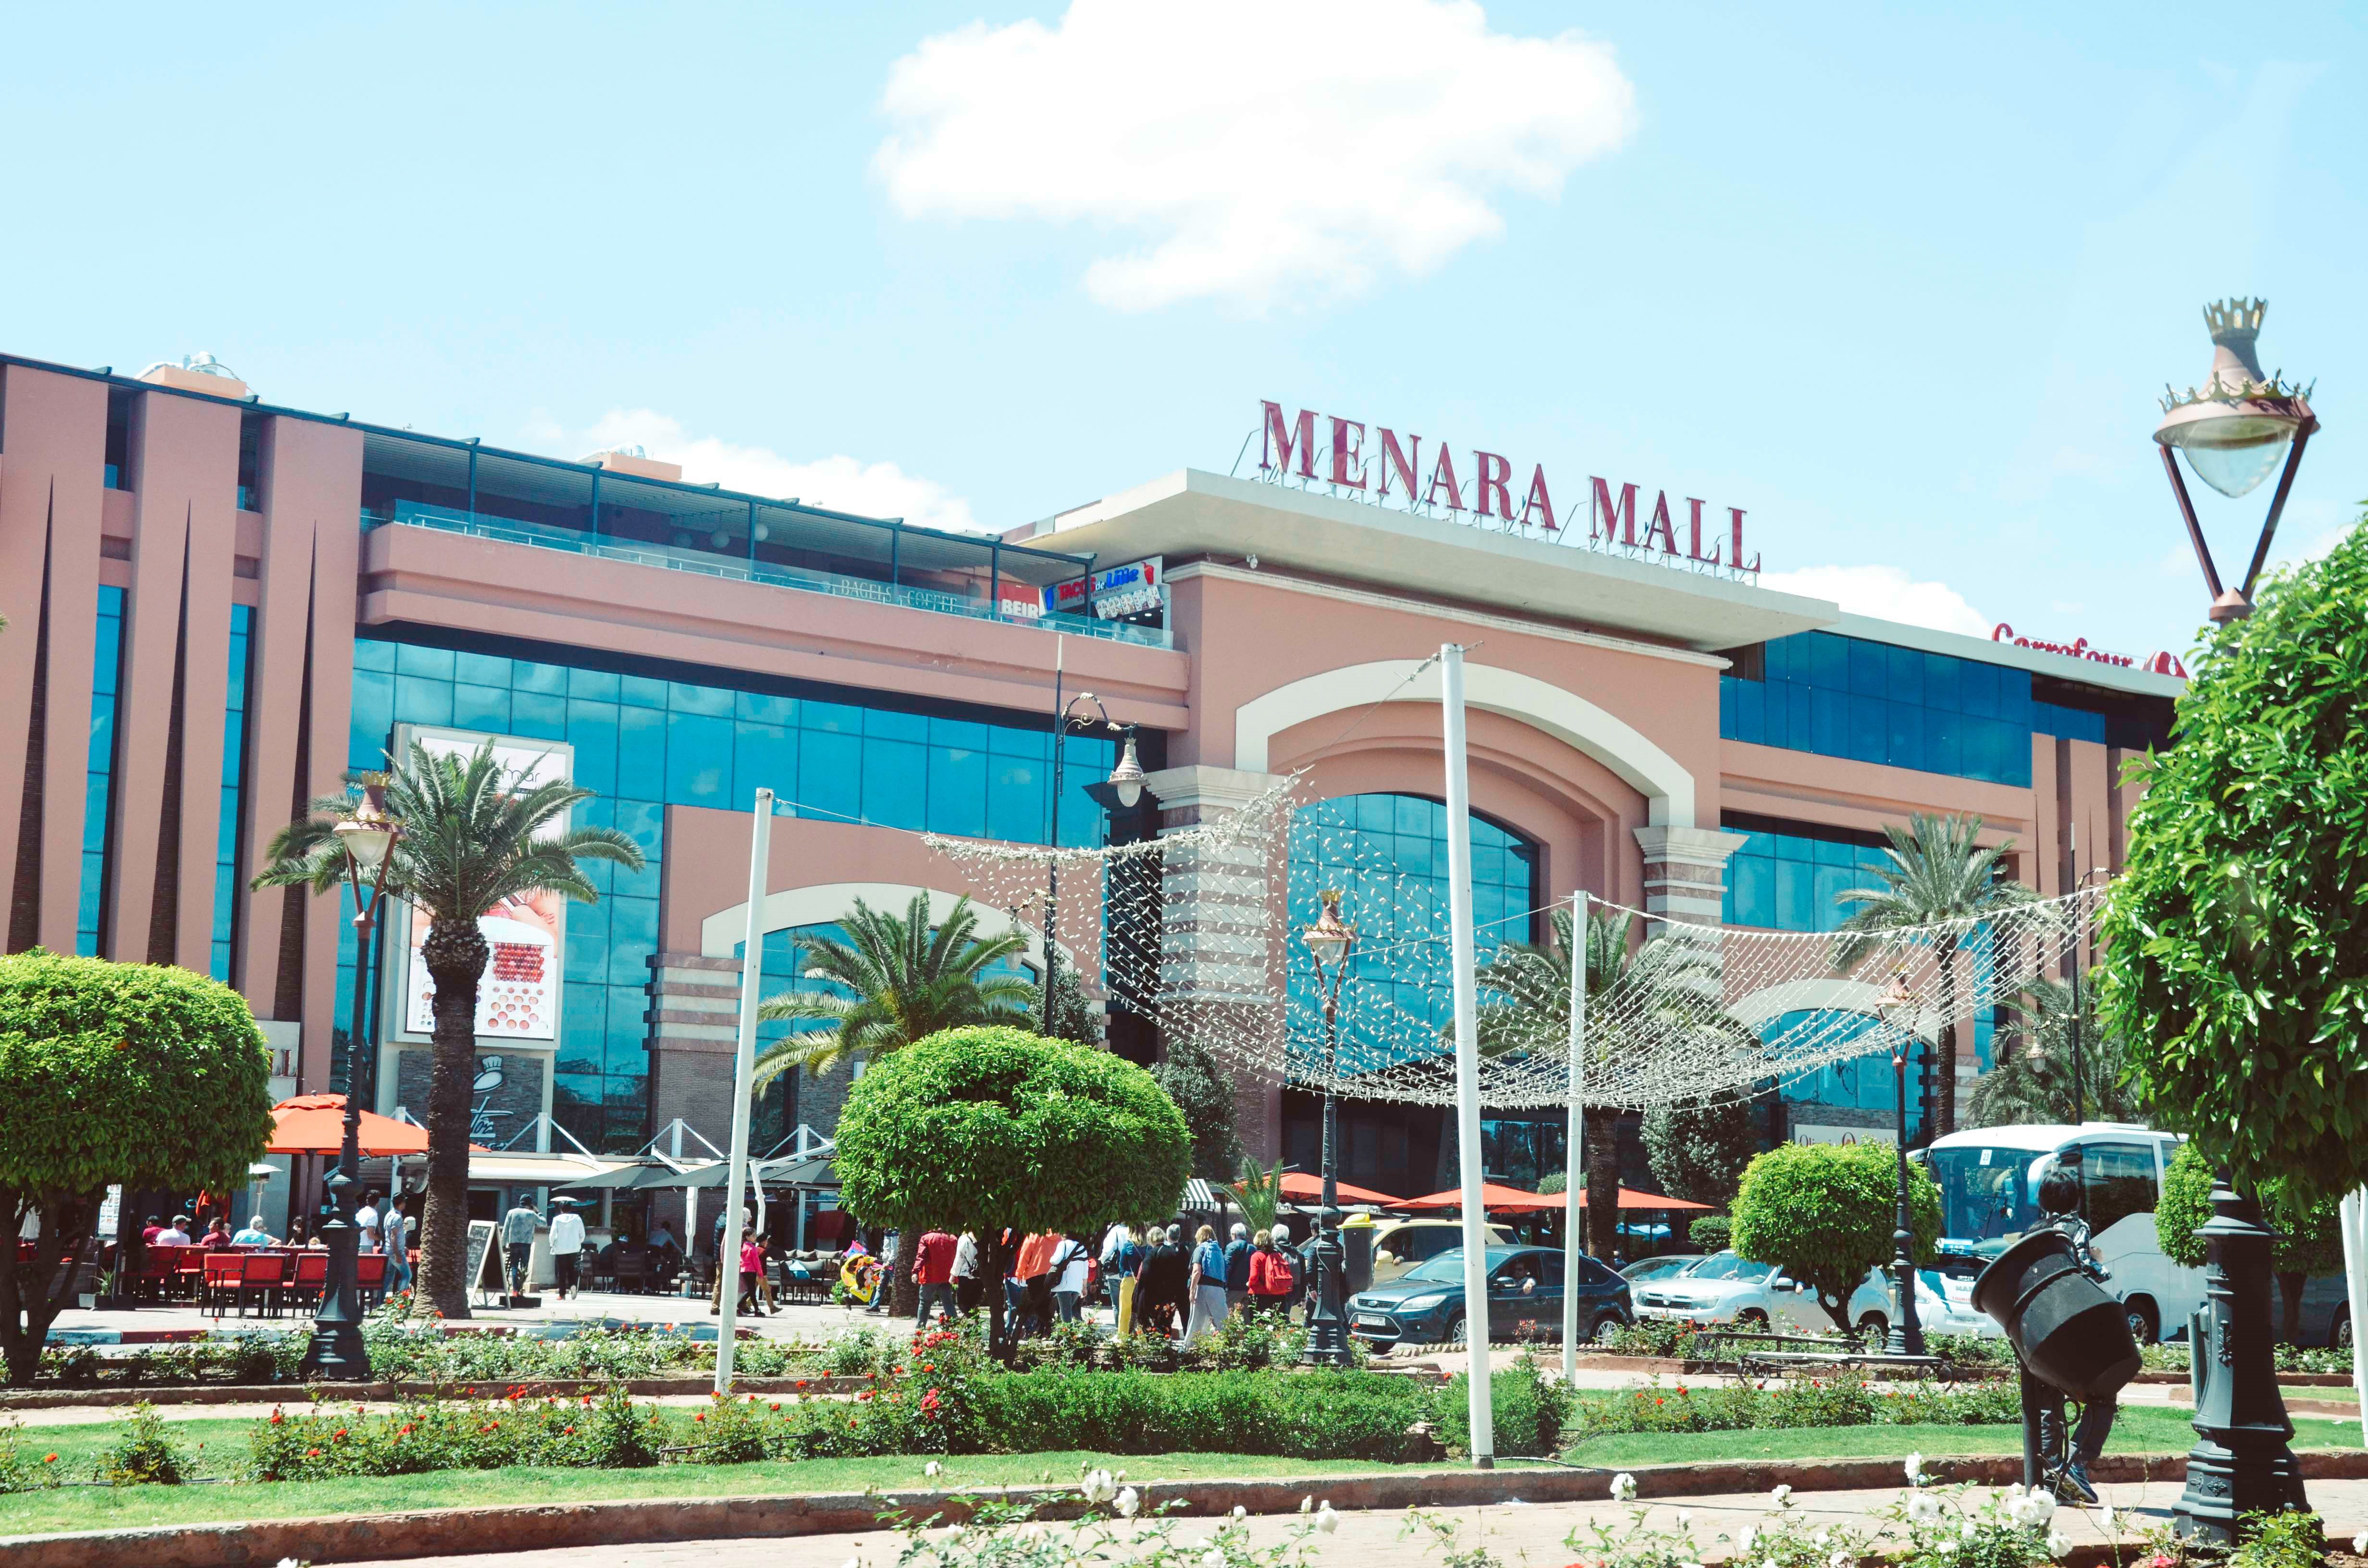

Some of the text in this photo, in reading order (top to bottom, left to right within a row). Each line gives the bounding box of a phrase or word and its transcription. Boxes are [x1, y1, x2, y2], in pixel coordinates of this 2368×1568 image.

[1258, 398, 1761, 573] MENARA MALL
[841, 579, 958, 613] BAGELS COFFEE
[1096, 581, 1105, 591] de
[1001, 599, 1038, 618] BEIR
